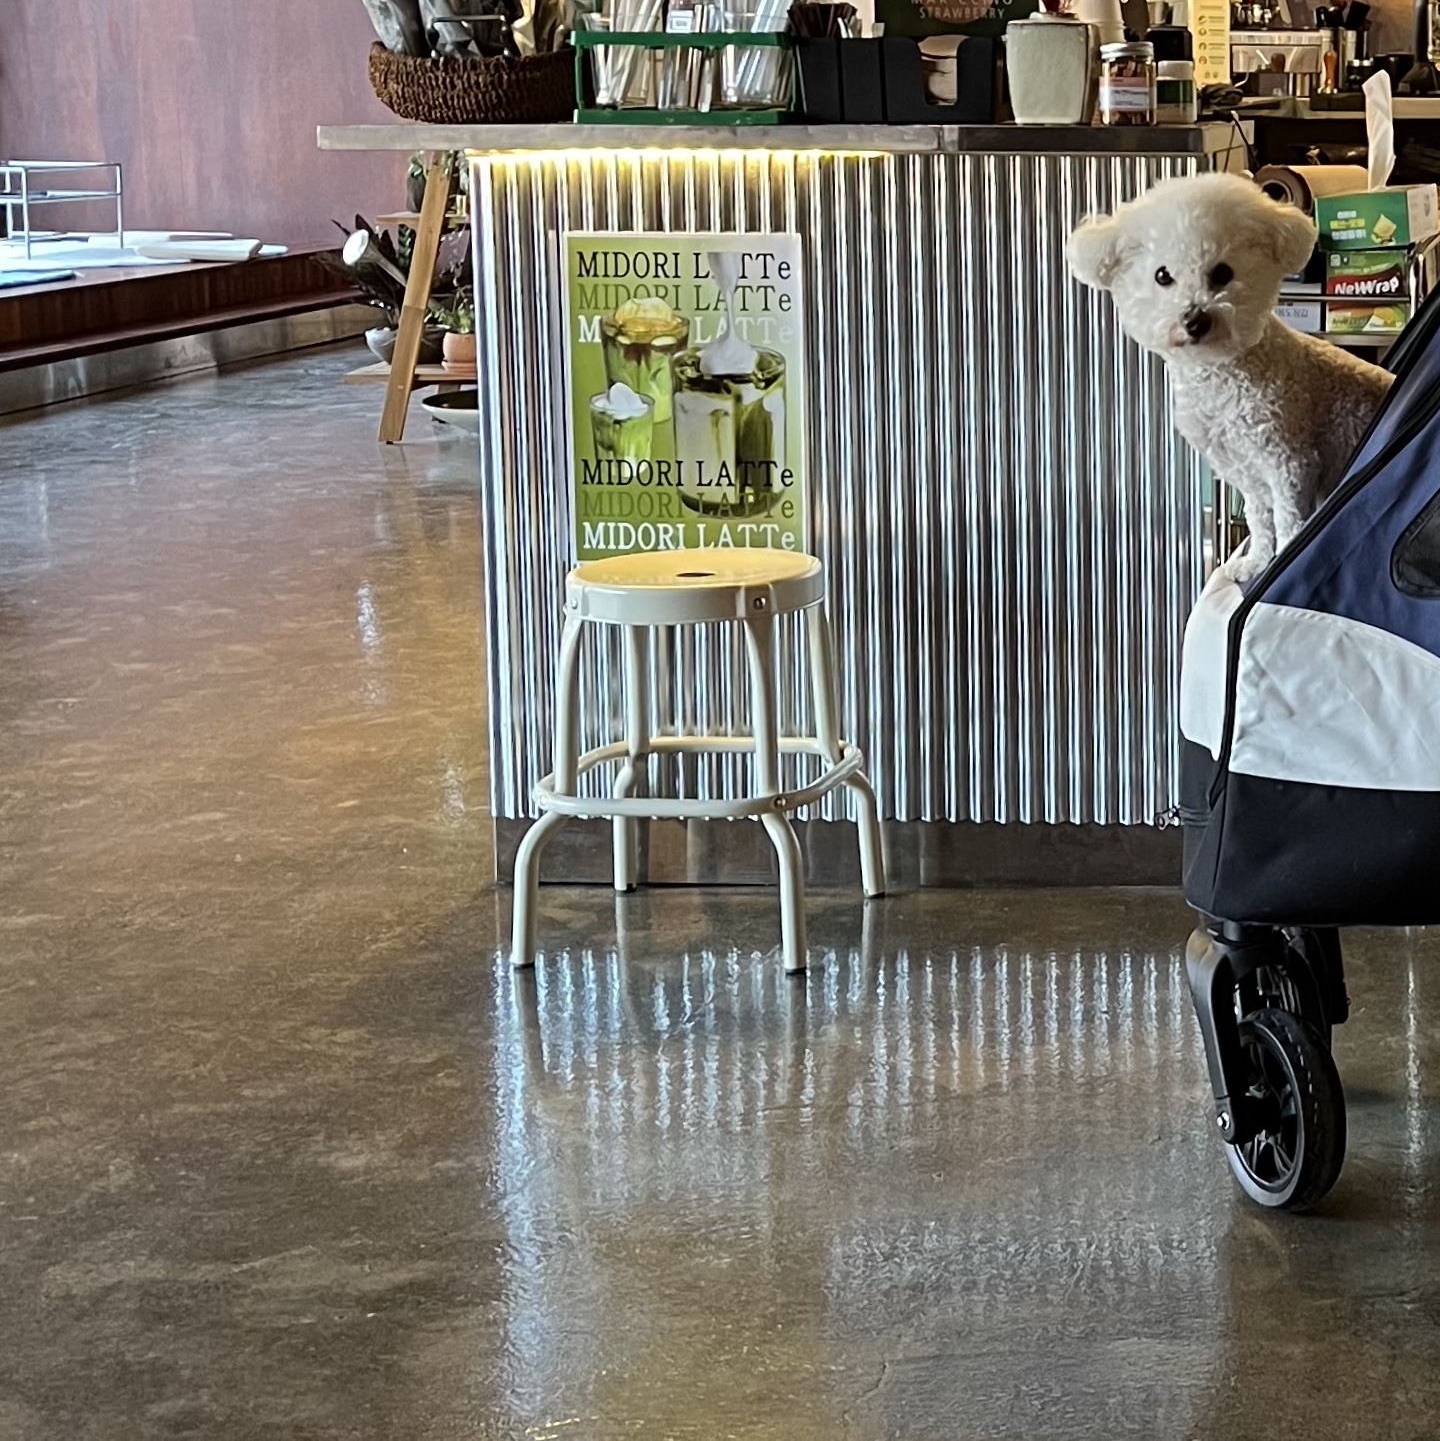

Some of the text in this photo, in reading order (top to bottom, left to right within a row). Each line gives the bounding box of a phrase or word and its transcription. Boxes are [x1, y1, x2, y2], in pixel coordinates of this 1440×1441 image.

[919, 6, 1005, 19] STRAWBERRY
[577, 251, 791, 280] MIDORI LTTe
[582, 459, 794, 488] MIDORI LATTe
[583, 491, 795, 519] MIDORI LATTe
[583, 522, 795, 550] MIDORI LATTe
